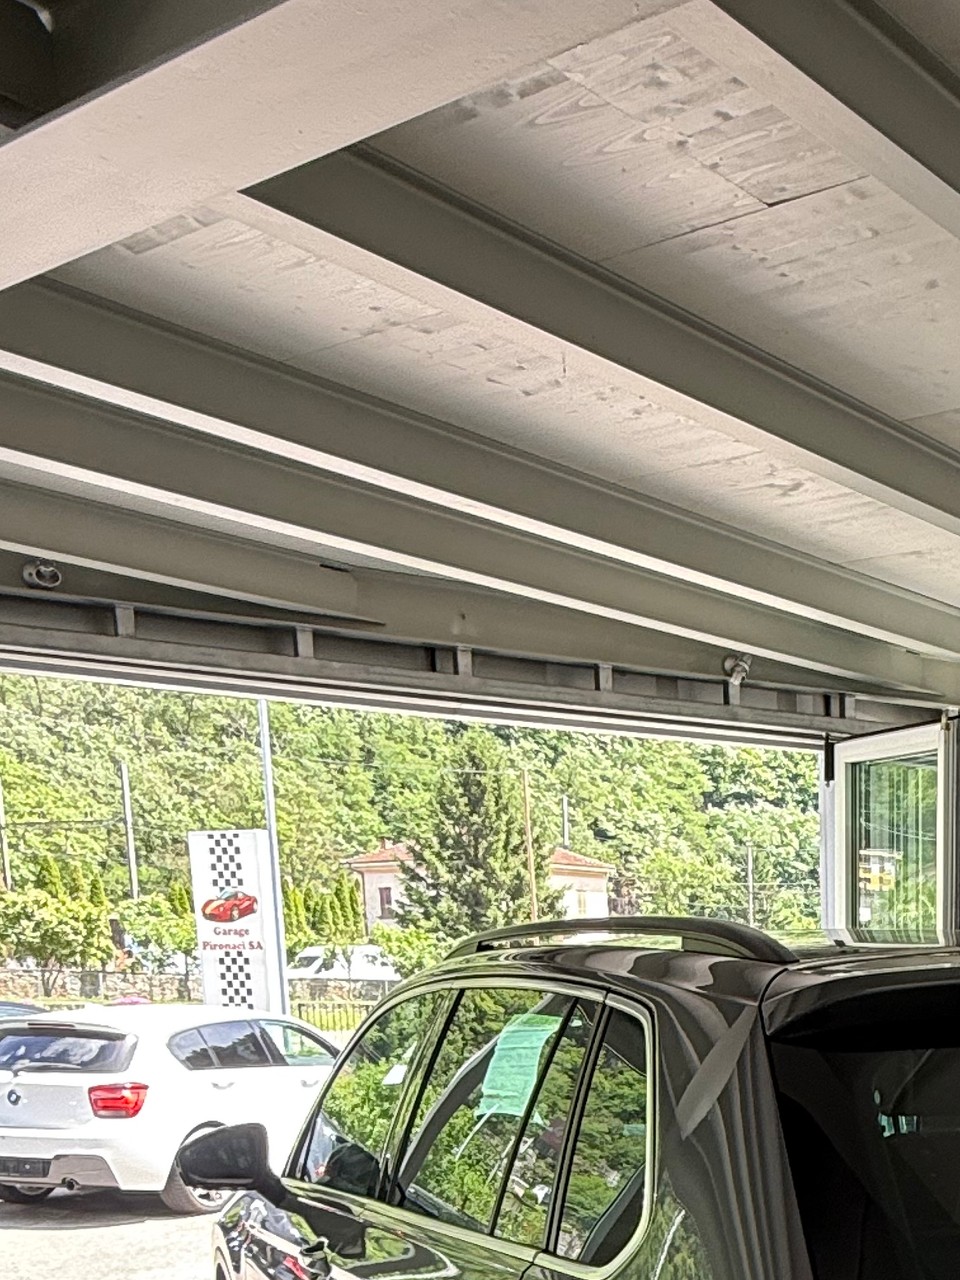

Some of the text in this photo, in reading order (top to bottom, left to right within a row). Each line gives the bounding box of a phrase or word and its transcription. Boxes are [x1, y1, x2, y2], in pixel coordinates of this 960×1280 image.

[213, 926, 250, 937] Garage
[202, 941, 263, 950] Pironaci SA
